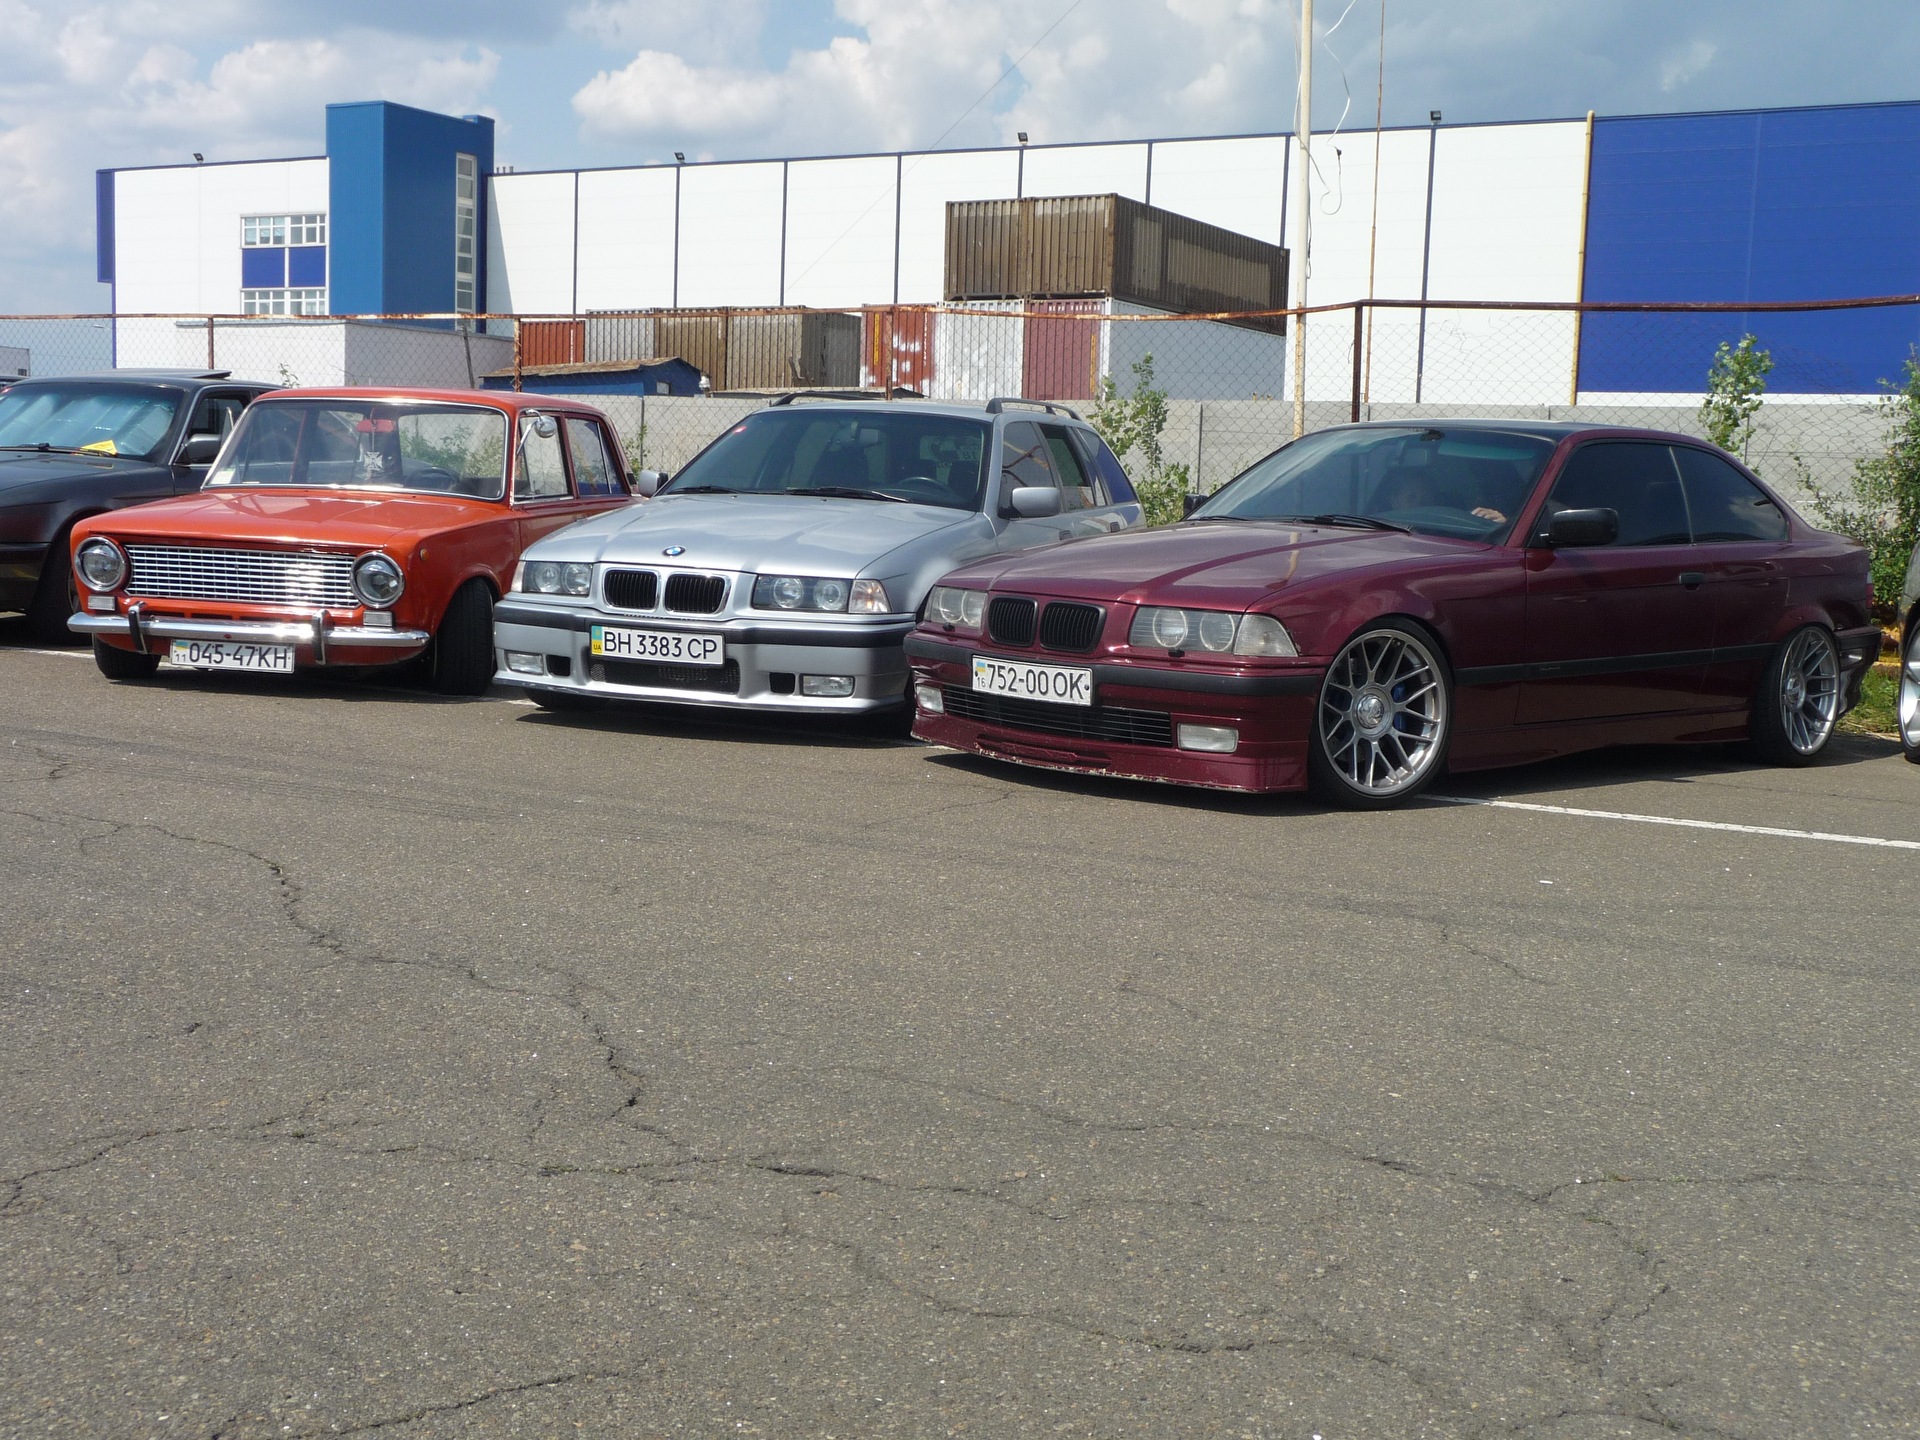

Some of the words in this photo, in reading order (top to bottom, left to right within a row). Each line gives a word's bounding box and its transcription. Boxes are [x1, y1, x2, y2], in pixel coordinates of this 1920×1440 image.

[593, 643, 602, 651] UA
[604, 631, 631, 654] BH
[636, 634, 682, 658] 3383
[687, 638, 717, 660] CP
[189, 642, 287, 669] 045-47KH
[977, 676, 986, 688] 16
